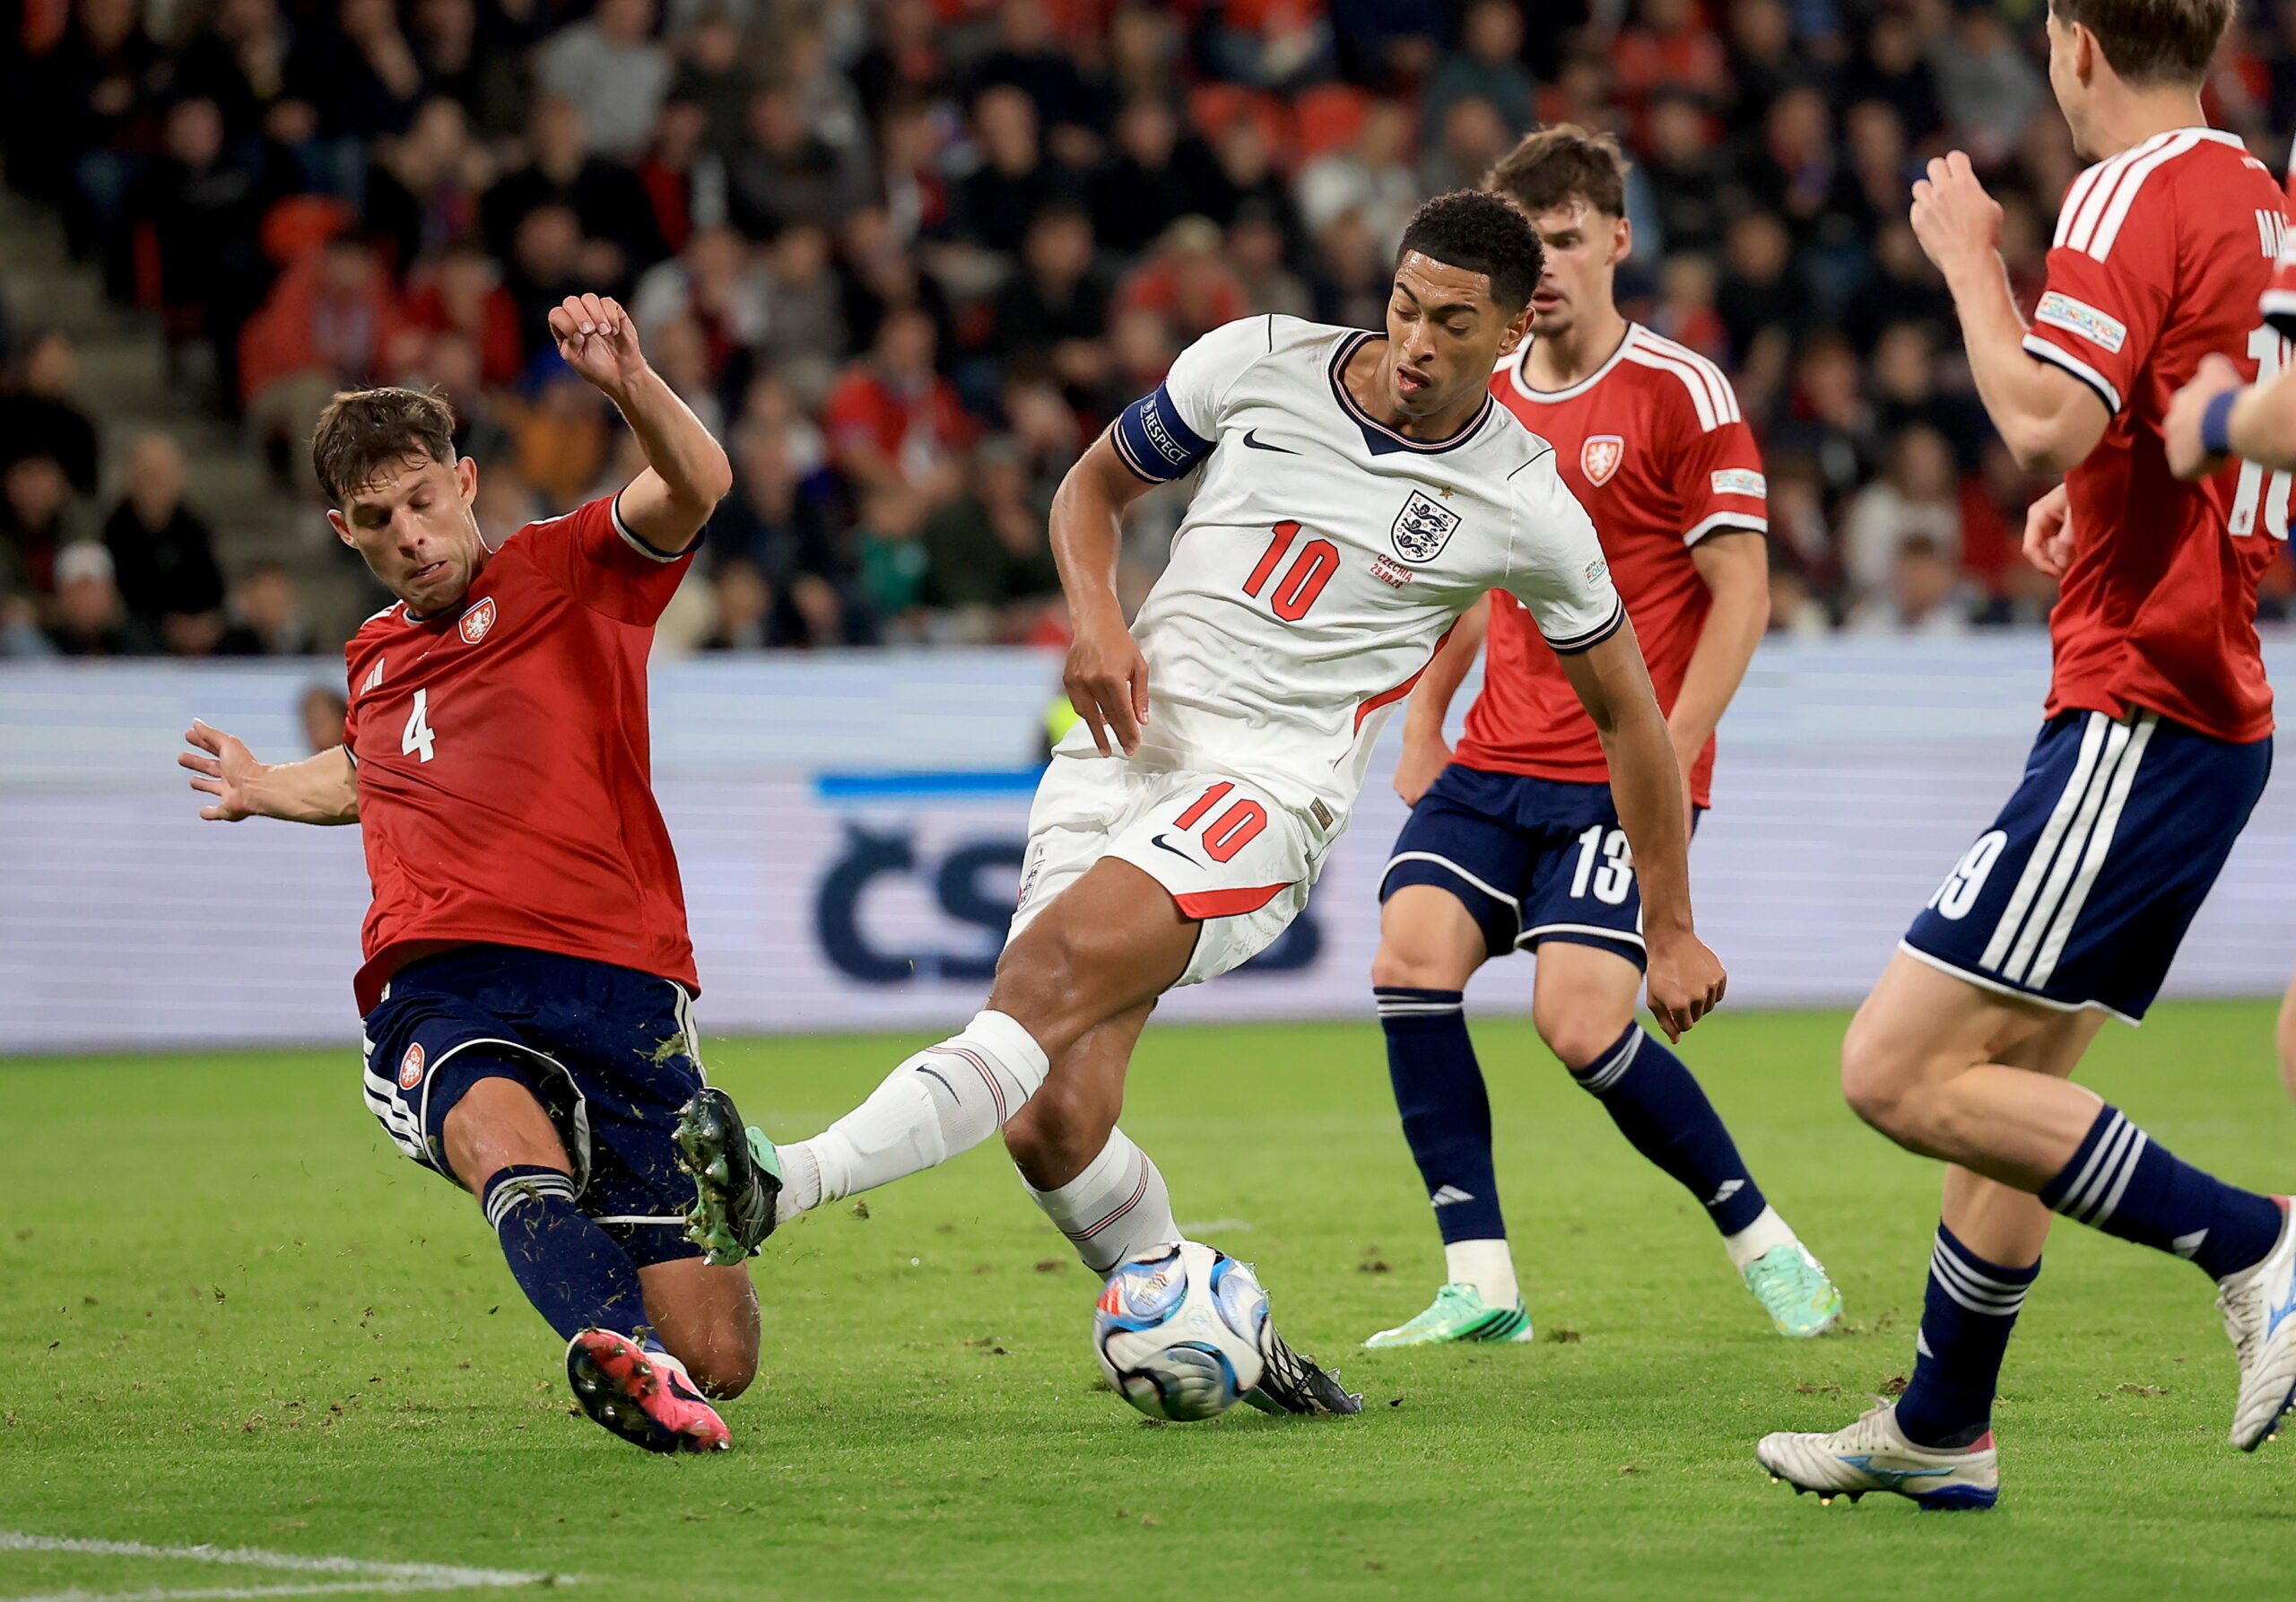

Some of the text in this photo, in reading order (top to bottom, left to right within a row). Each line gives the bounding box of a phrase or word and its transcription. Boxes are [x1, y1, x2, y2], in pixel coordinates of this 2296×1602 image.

[1144, 412, 1187, 462] RESPECT
[1242, 519, 1340, 622] 10
[1378, 553, 1413, 583] CZECHIA
[401, 687, 436, 763] 4
[1172, 781, 1267, 864] 10
[1570, 824, 1635, 905] 13
